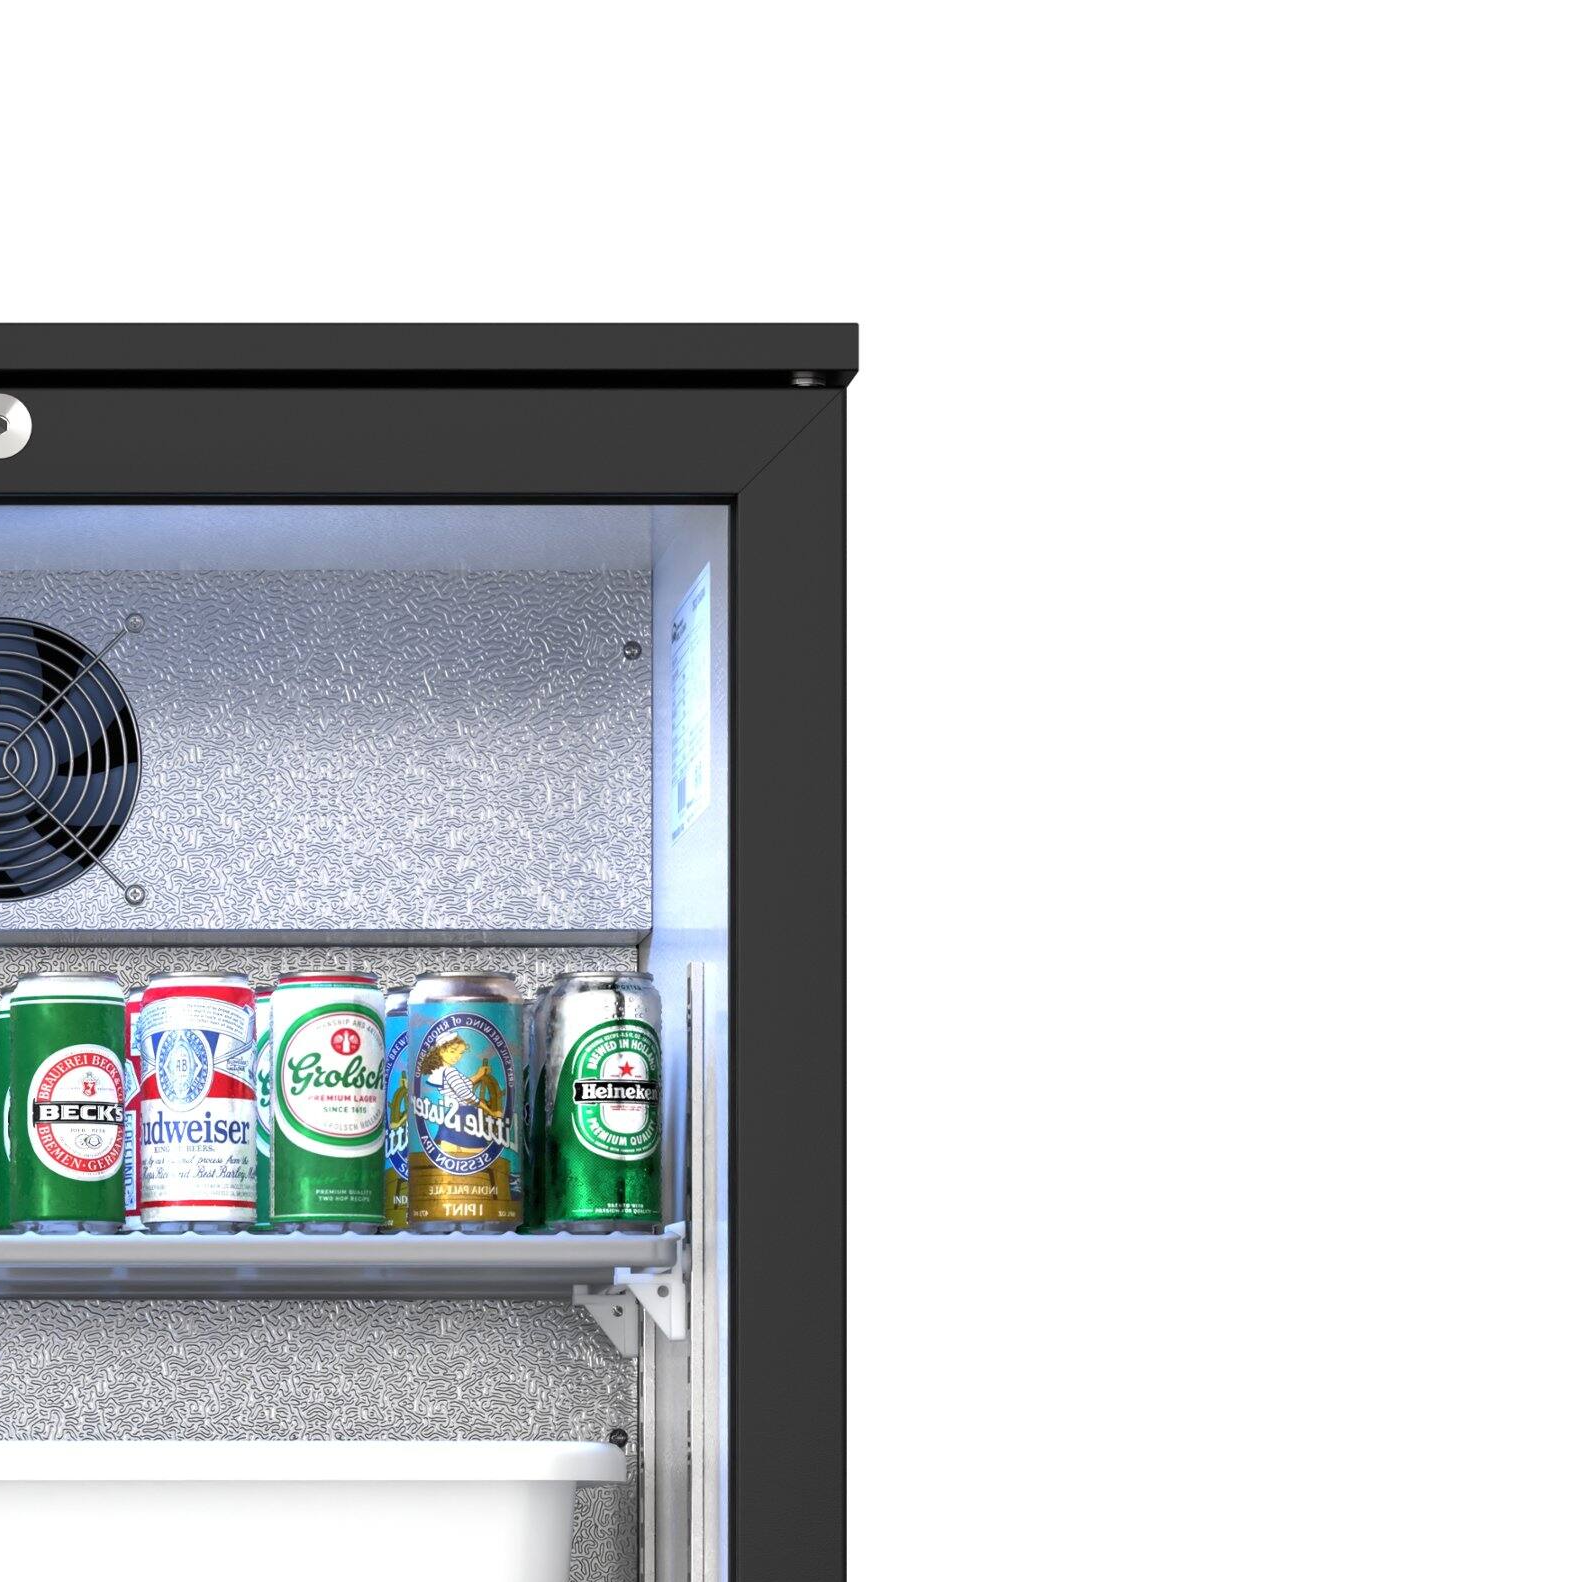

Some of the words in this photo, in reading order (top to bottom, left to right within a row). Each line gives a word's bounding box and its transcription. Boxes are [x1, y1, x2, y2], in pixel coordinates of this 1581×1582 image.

[619, 1039, 630, 1048] IN
[39, 1054, 88, 1100] BRAUEREI
[287, 1052, 384, 1096] Grolsch
[353, 1095, 377, 1103] LAGER
[142, 1110, 250, 1146] udweiser
[393, 1195, 408, 1204] IND
